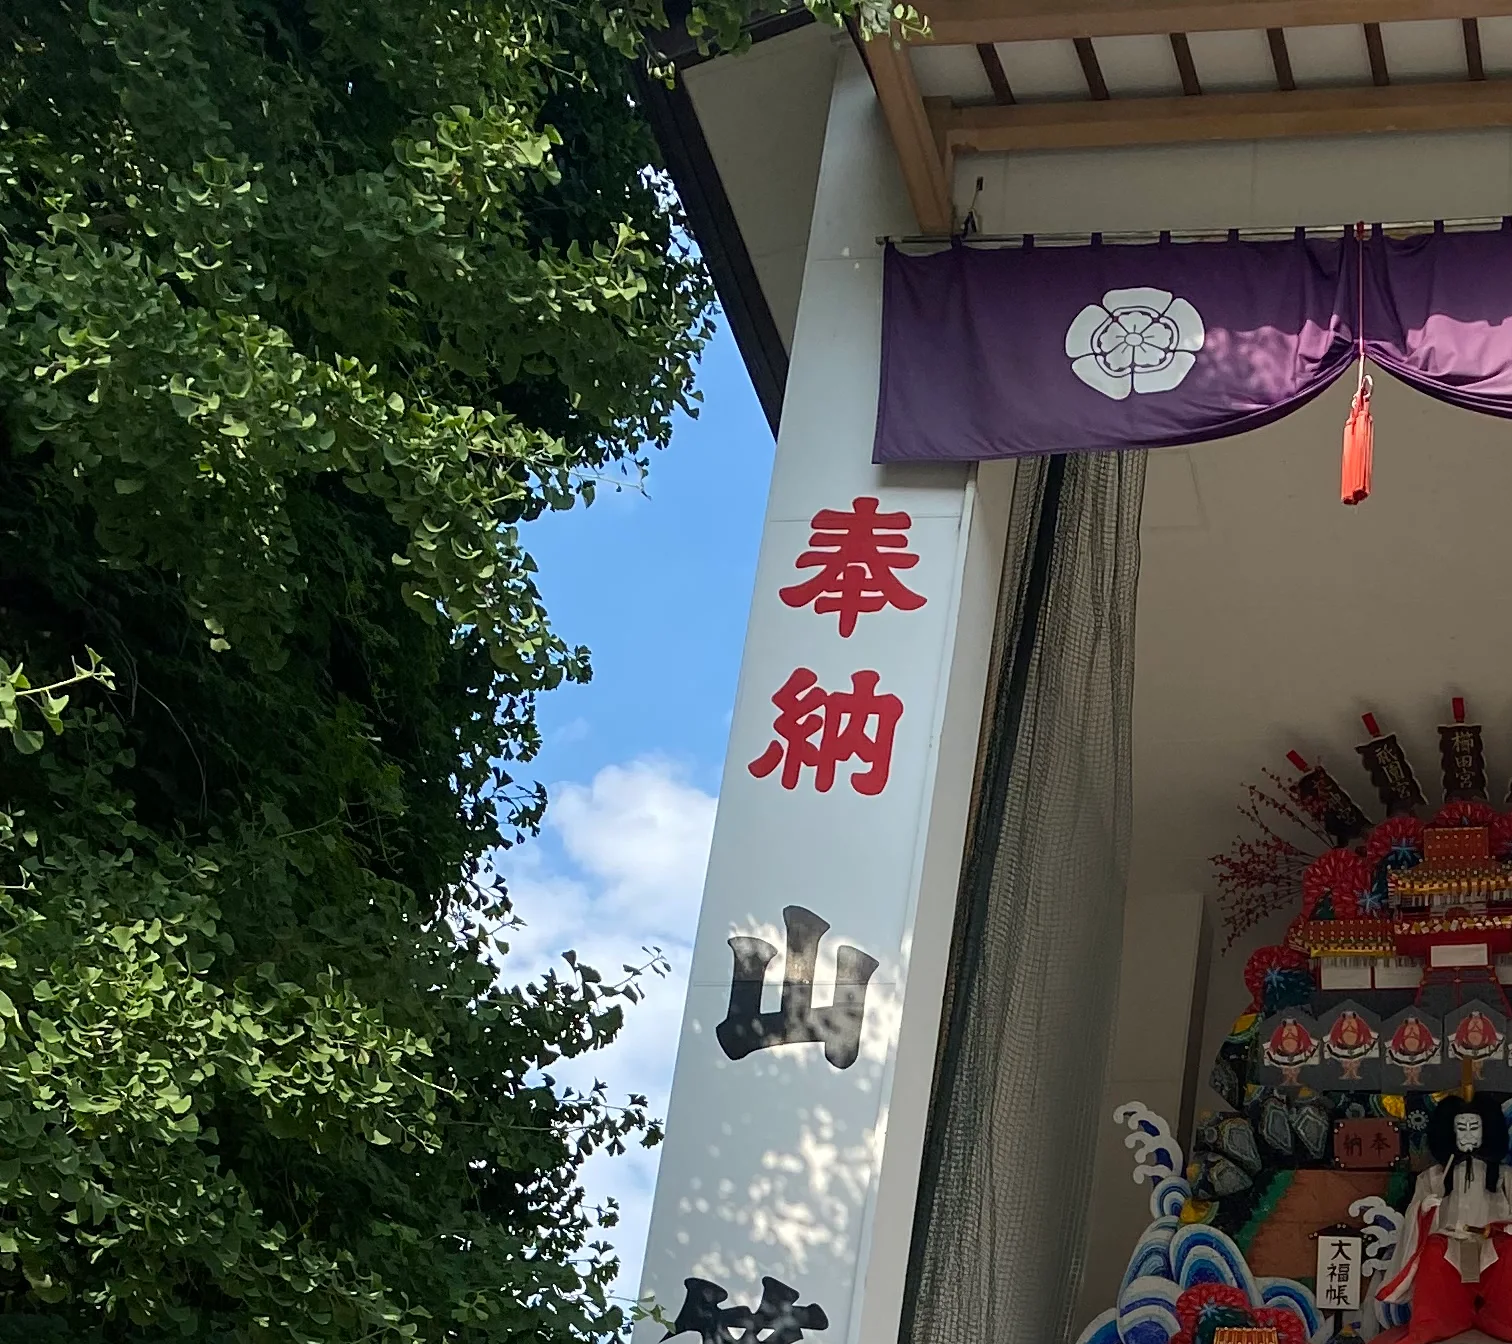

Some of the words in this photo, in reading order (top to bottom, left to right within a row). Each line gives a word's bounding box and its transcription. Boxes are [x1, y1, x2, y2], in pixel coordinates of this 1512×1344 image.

[747, 496, 928, 796] 奉納
[1375, 743, 1412, 798] 祇園宮
[1451, 731, 1475, 789] 櫛田宮
[1325, 1239, 1352, 1306] 大福帳
